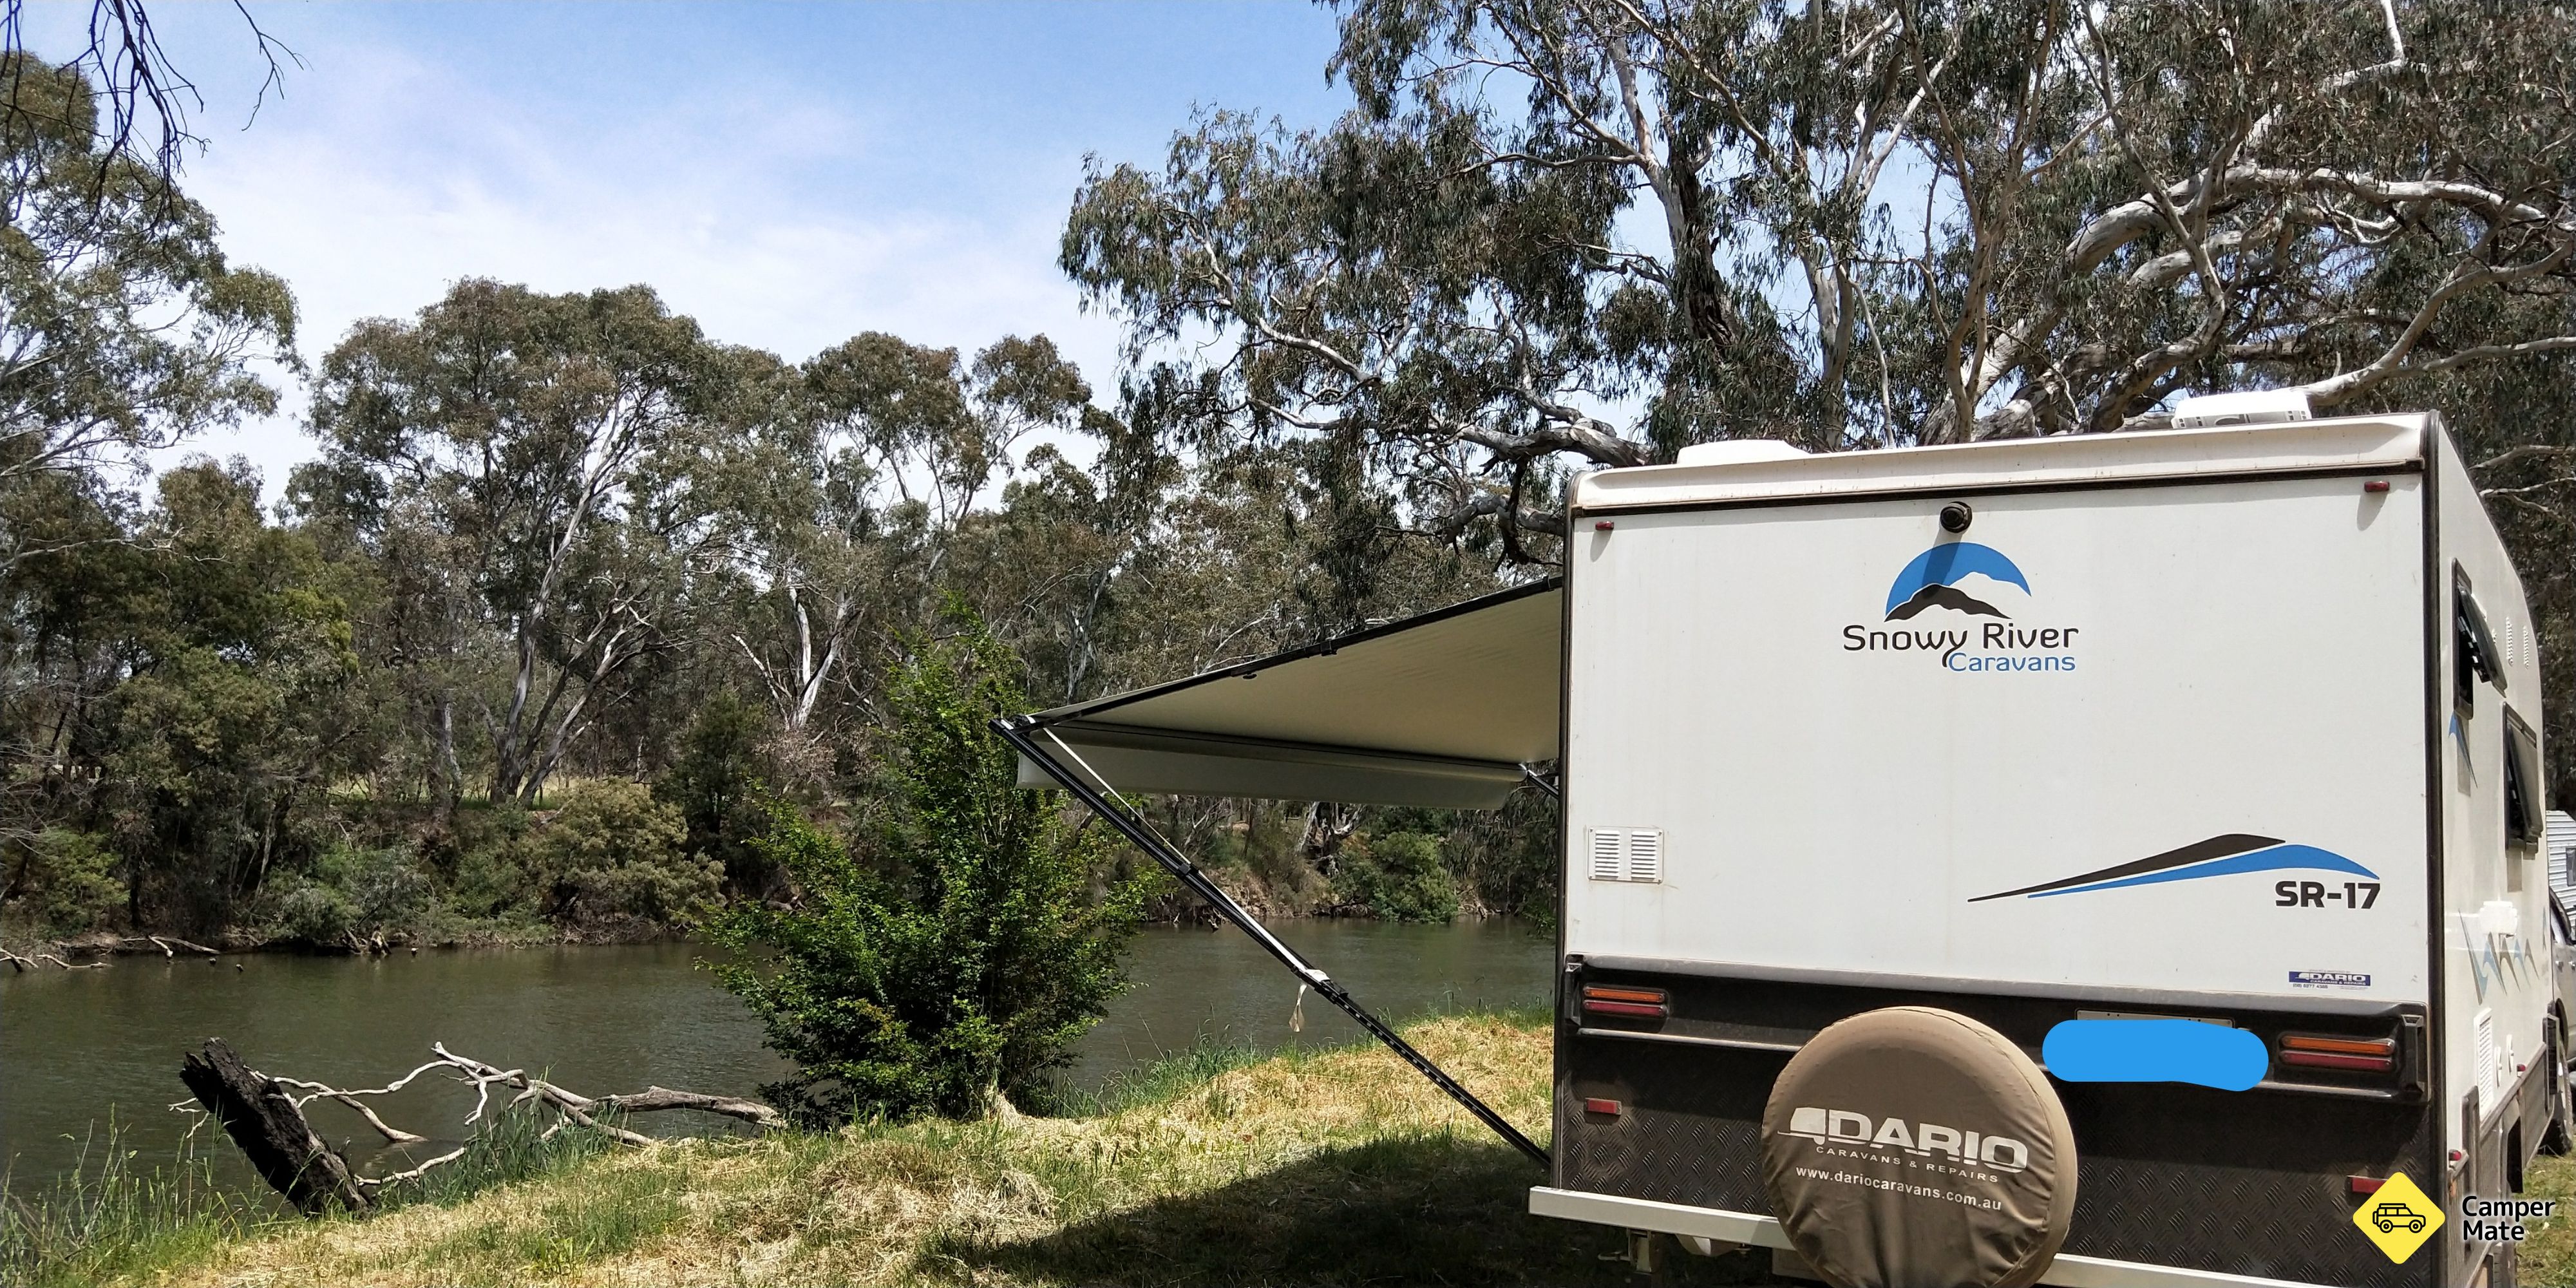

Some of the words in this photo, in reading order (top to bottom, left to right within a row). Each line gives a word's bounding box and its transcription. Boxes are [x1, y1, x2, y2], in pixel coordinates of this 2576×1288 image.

[1842, 625, 1968, 668] Snowy
[1983, 623, 2079, 649] River
[1948, 652, 2076, 672] Caravans
[2275, 880, 2381, 909] SR-17
[2310, 973, 2366, 982] DARIO
[1828, 1109, 2028, 1173] DARIO
[1816, 1146, 1901, 1165] CARAVANS
[1926, 1163, 1998, 1182] REPAIRS
[1795, 1167, 2002, 1211] www.dariocaravans.com.au
